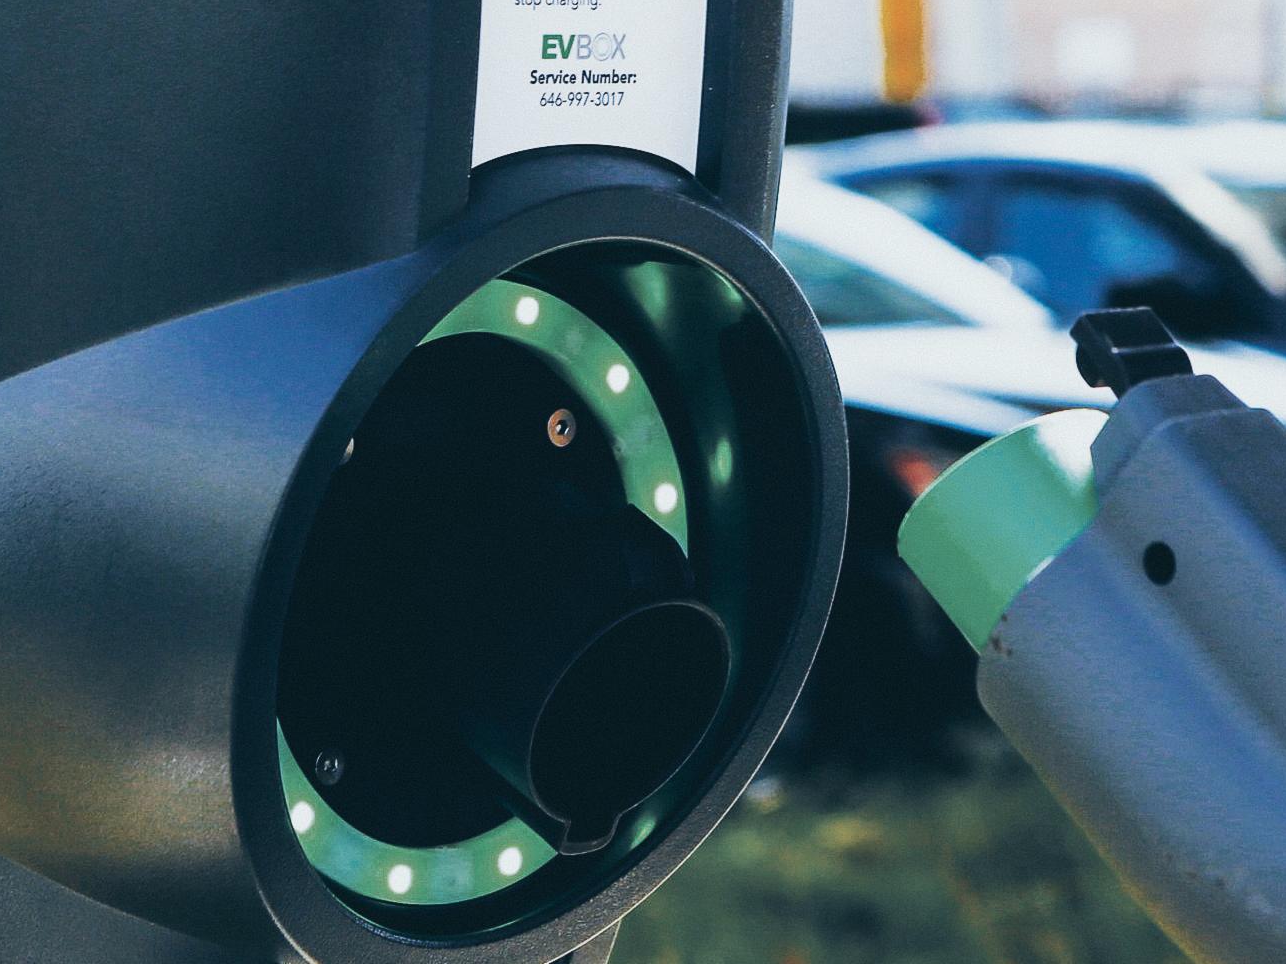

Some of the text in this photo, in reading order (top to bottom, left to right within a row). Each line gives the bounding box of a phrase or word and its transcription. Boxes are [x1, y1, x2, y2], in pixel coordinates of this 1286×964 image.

[541, 28, 626, 61] EVBOX
[530, 69, 637, 85] Service Number:
[540, 92, 625, 108] 646-997-3017
